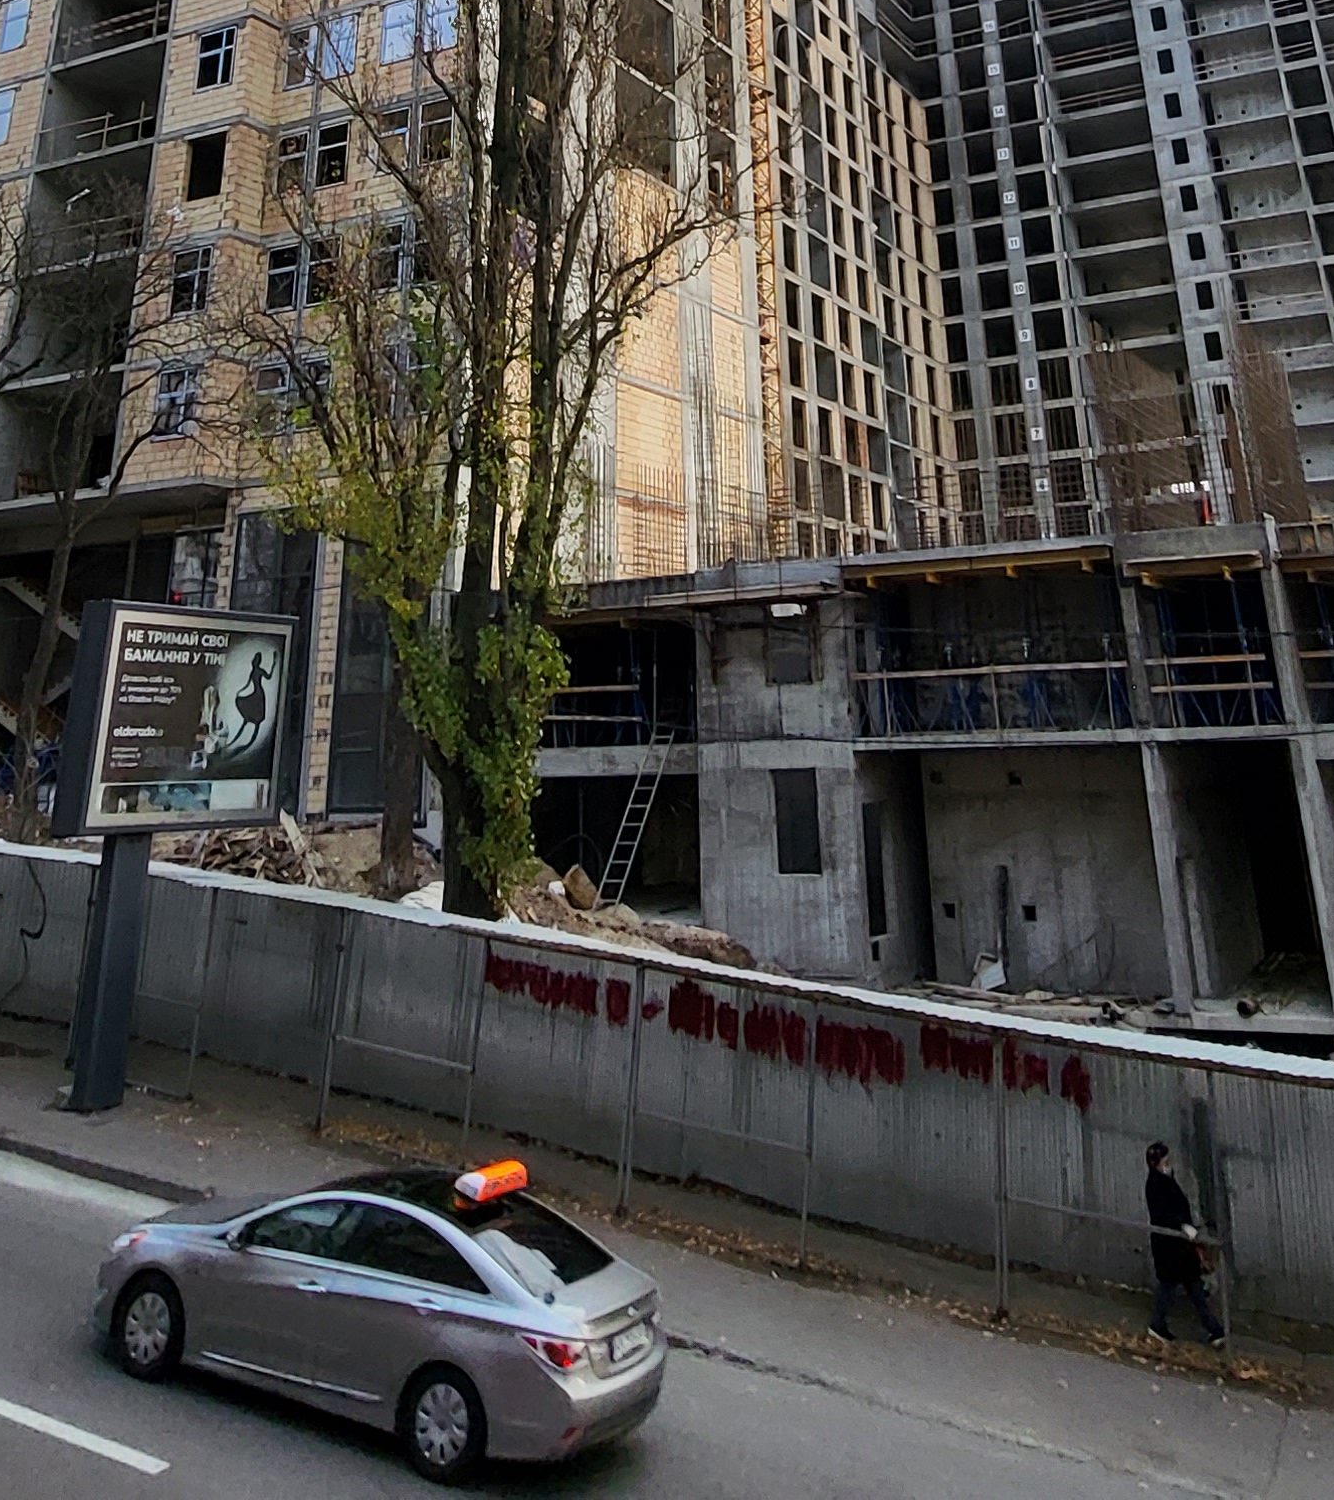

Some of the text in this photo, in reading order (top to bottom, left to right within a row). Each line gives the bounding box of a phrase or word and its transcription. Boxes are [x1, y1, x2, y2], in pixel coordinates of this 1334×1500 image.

[126, 629, 230, 648] НЕ ТРИМАЙ СВОЇ
[123, 647, 190, 664] БАЖАННЯ
[192, 651, 201, 665] У
